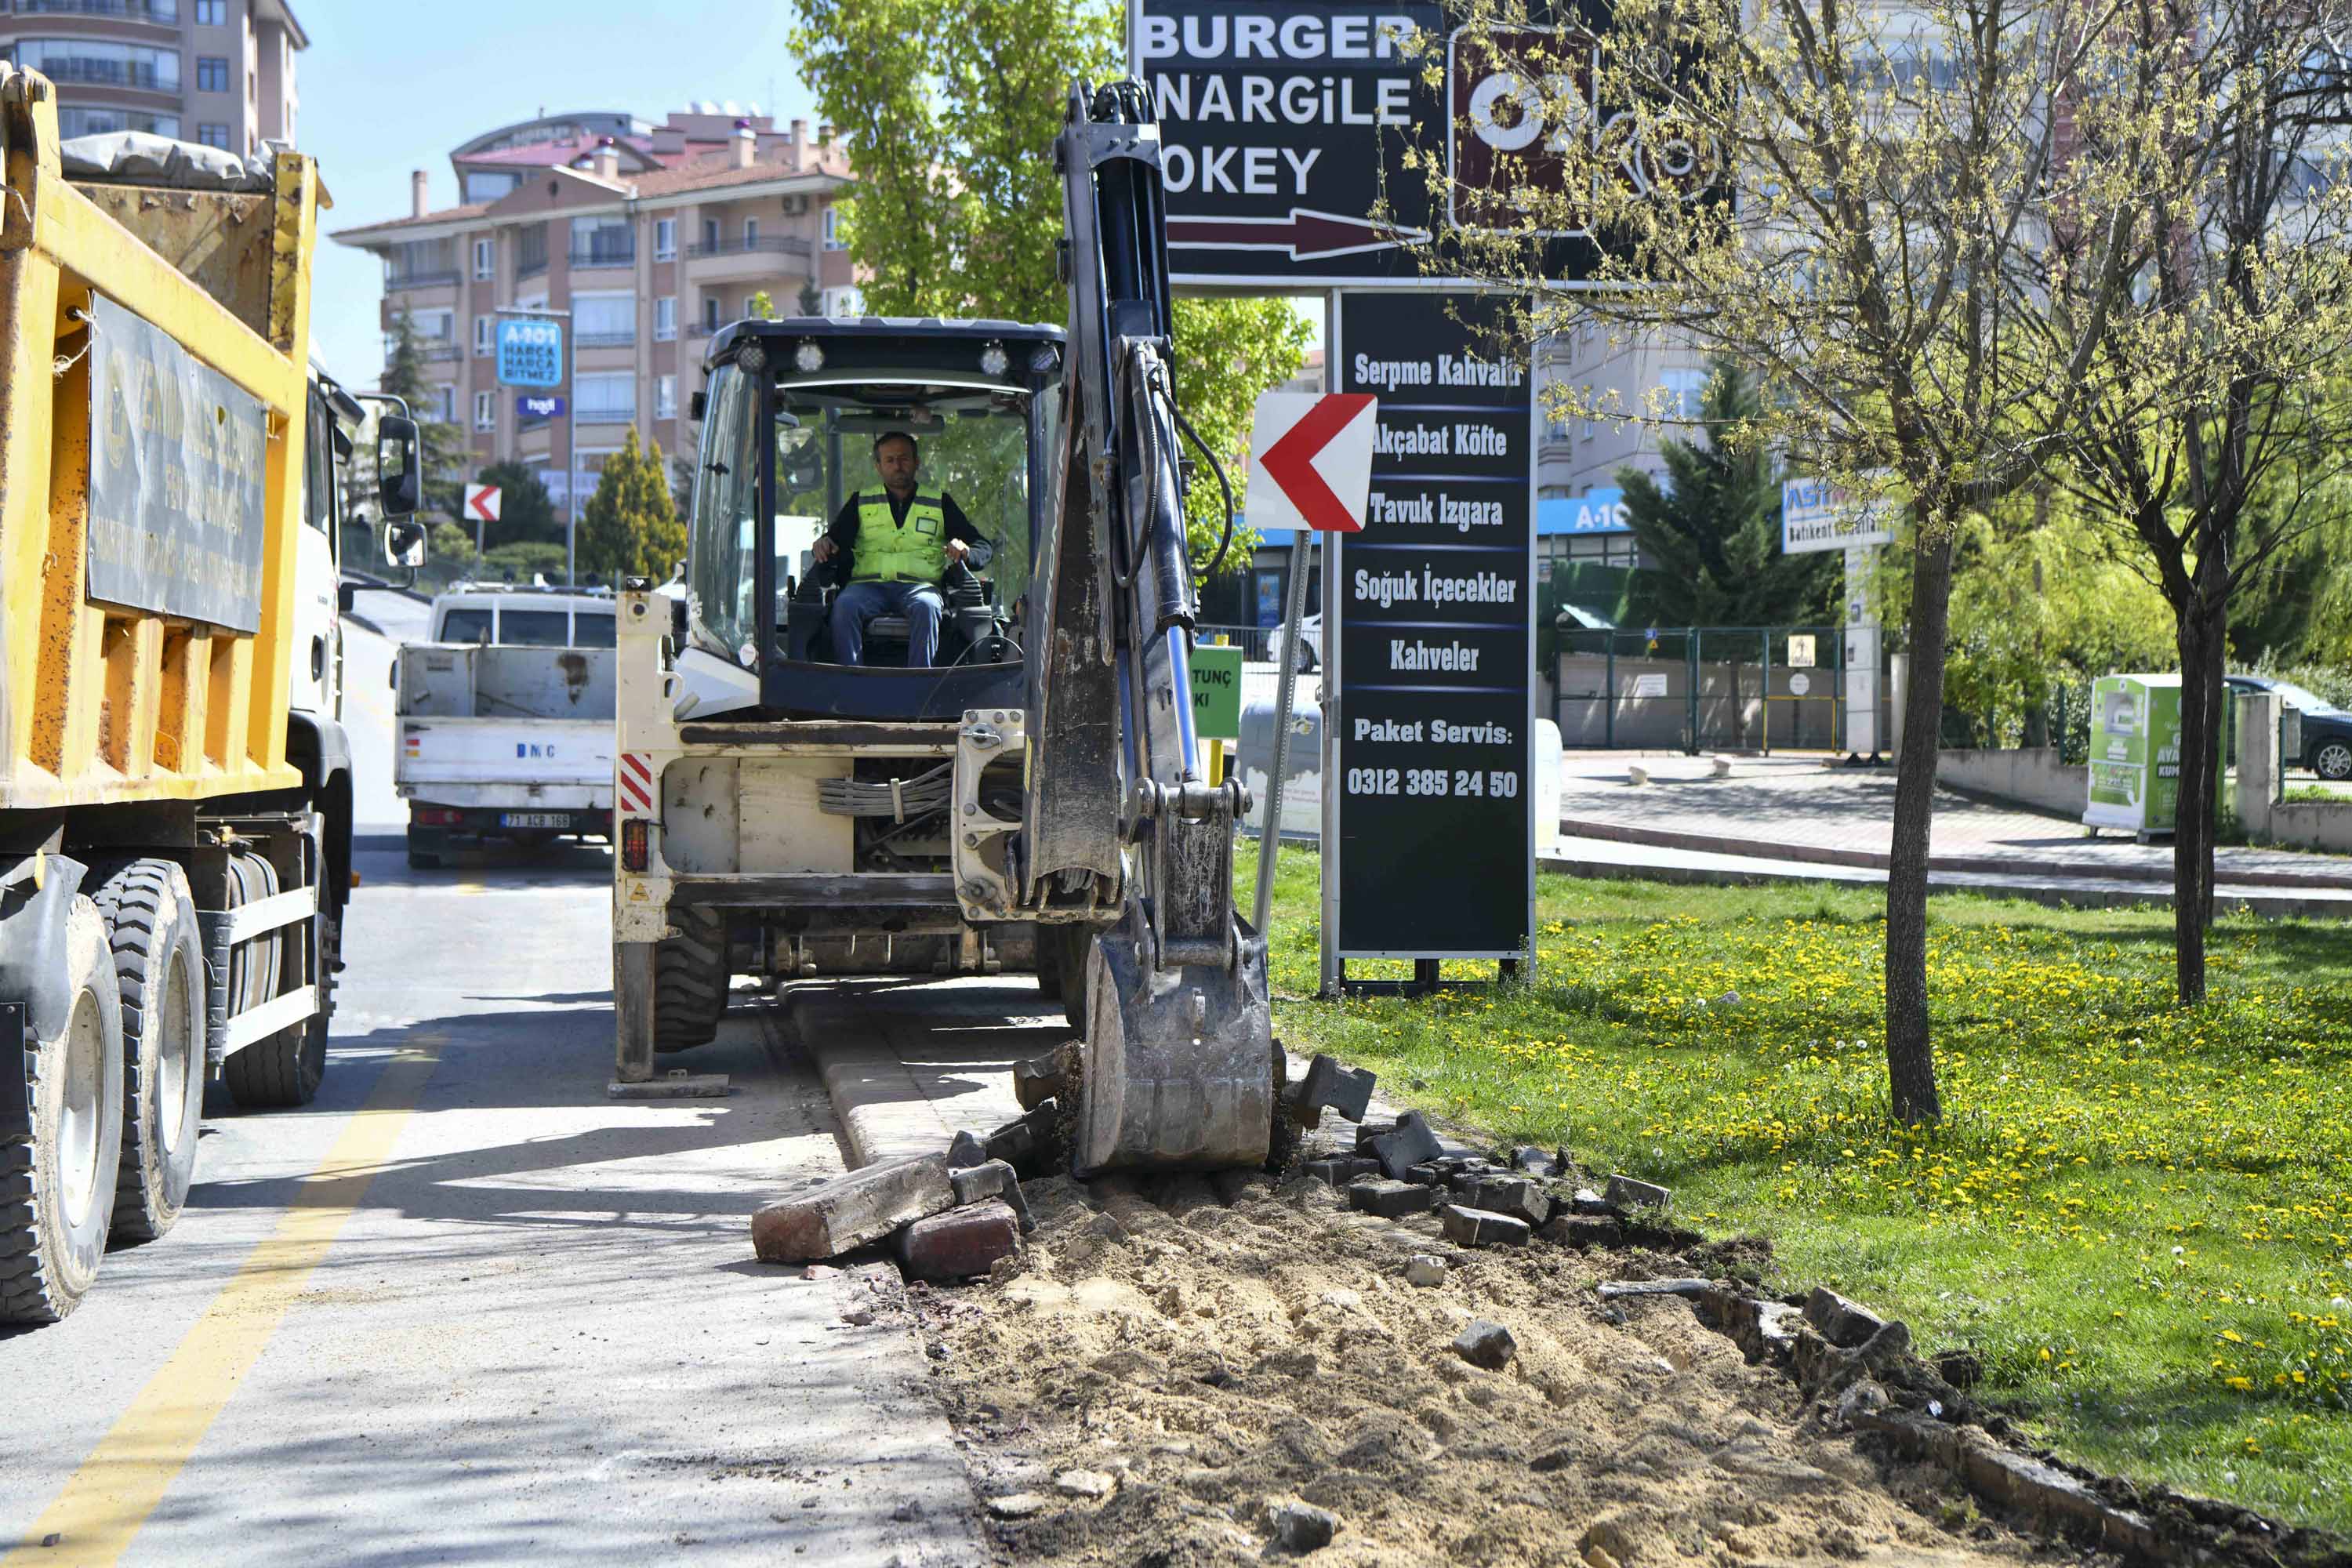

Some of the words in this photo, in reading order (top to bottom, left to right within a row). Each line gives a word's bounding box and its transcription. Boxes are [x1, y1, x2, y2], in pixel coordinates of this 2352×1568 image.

[1142, 15, 1421, 59] BURGER
[1161, 144, 1322, 195] OKEY
[1355, 353, 1432, 392] Serpme
[1372, 423, 1450, 462] Akçabat
[1454, 424, 1508, 456] Köfte
[1370, 492, 1434, 524] Tavuk
[1439, 493, 1504, 532] Izgara
[1355, 568, 1417, 608] Soğuk
[1423, 562, 1517, 609] İçecekler
[1390, 639, 1479, 672] Kahveler
[1192, 669, 1232, 689] TUNÇ
[1354, 718, 1424, 742] Paket
[1430, 719, 1513, 746] Servis:
[1348, 768, 1399, 795] 0312
[1406, 769, 1449, 796] 385
[1454, 770, 1483, 797] 24
[1490, 771, 1519, 798] 50
